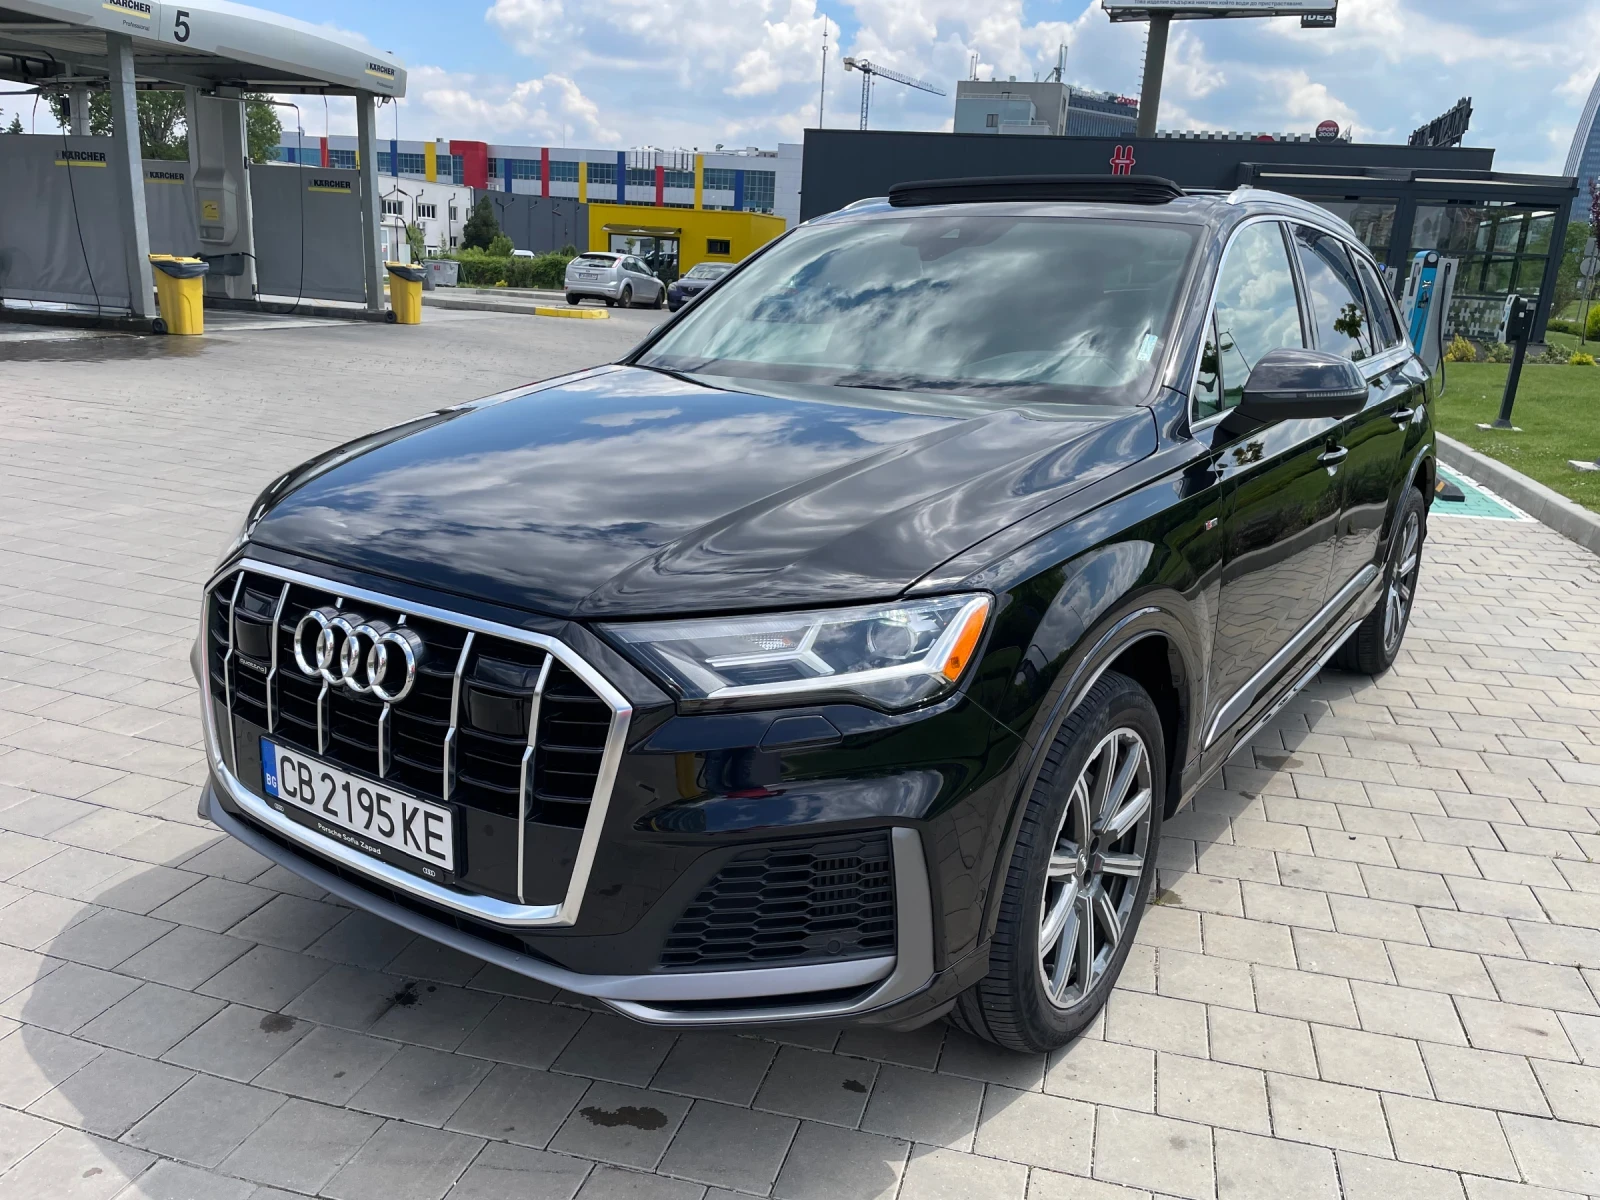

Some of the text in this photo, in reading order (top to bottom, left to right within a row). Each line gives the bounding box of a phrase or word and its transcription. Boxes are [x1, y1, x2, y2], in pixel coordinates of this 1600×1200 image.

[173, 9, 191, 43] 5
[266, 773, 277, 788] BG
[317, 822, 382, 855] Porsche Sofia Zapad
